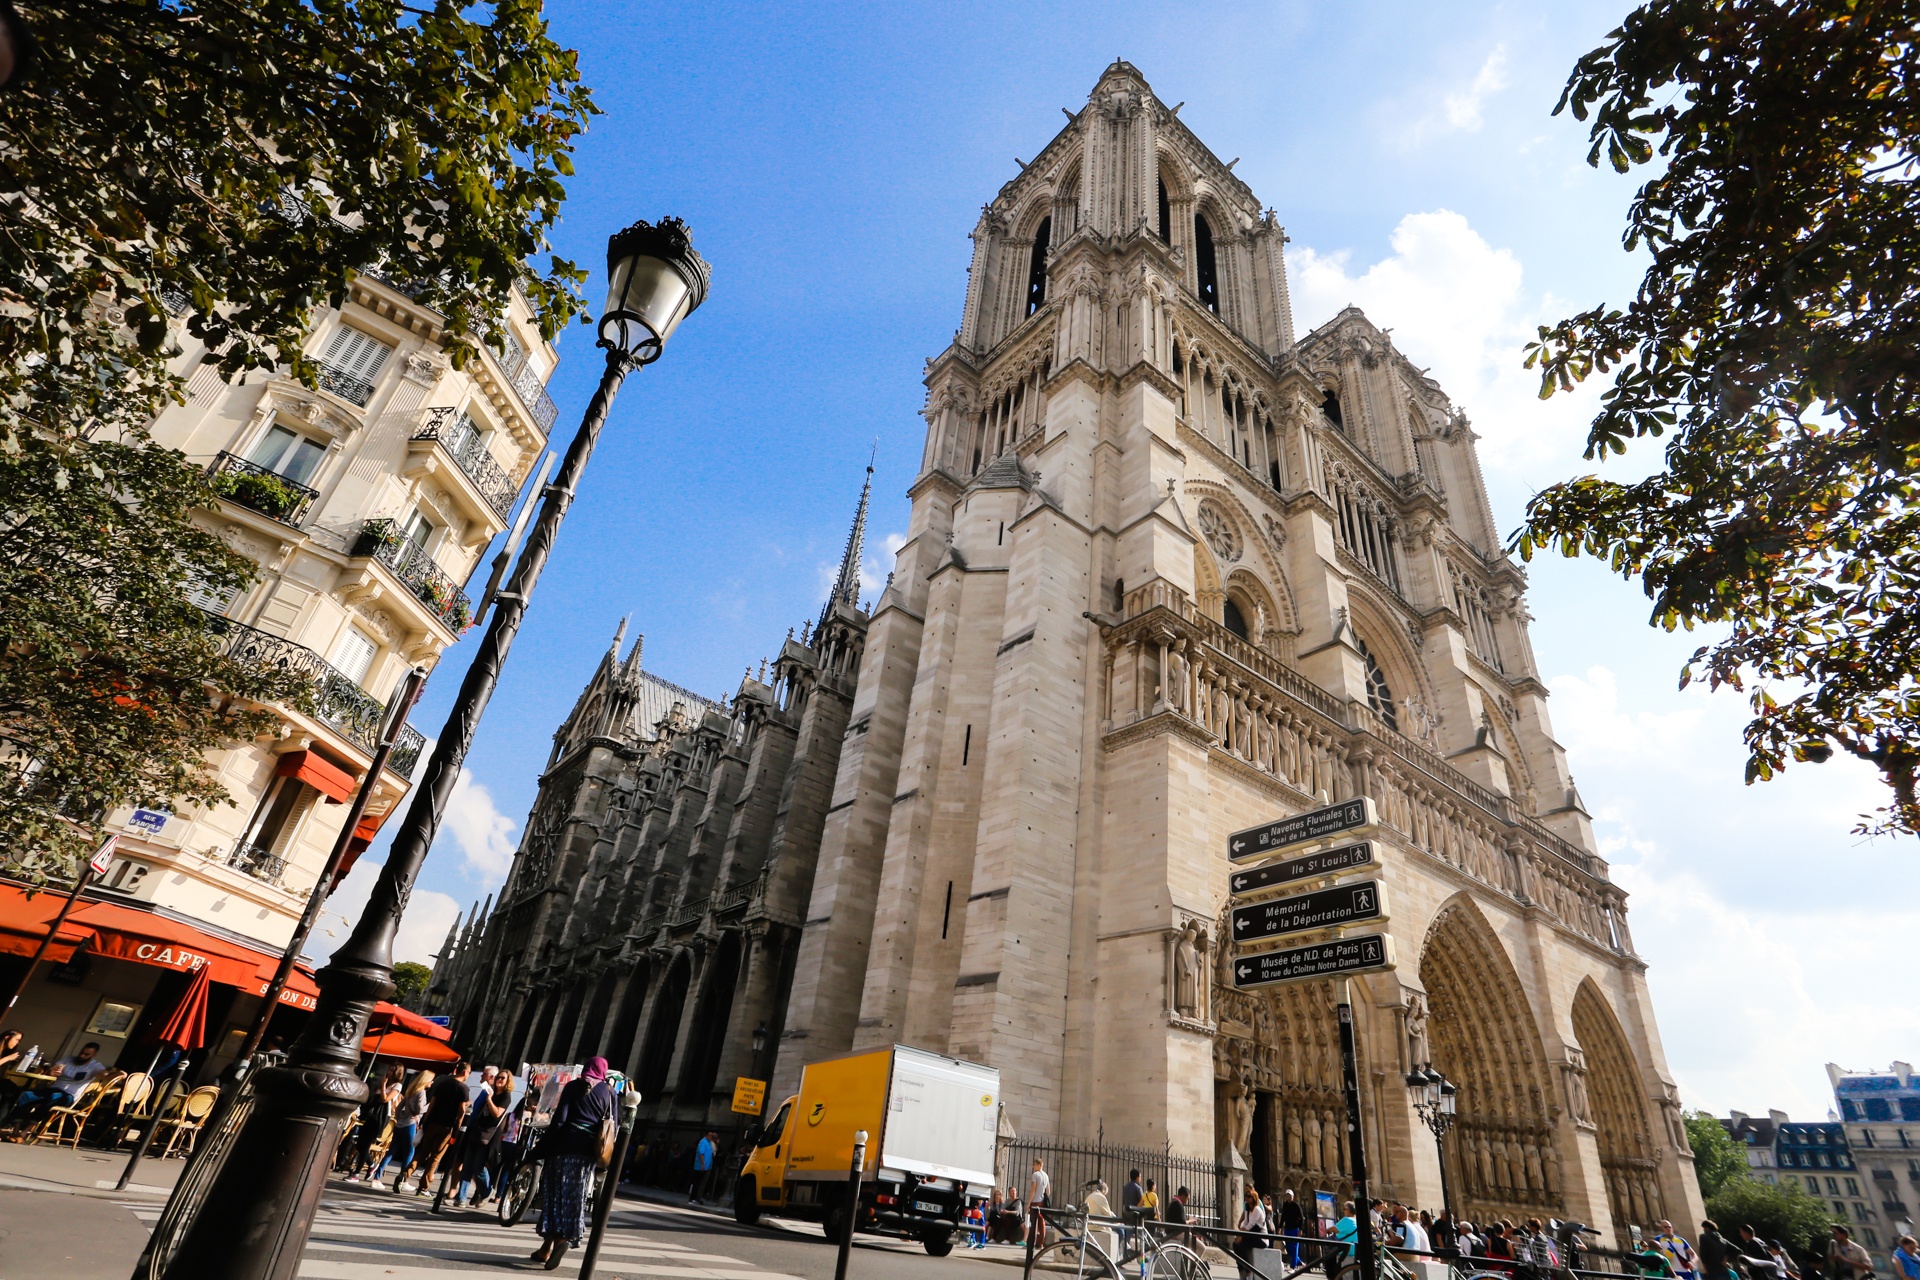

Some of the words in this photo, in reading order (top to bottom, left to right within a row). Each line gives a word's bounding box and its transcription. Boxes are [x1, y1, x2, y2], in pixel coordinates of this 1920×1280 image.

[130, 819, 162, 831] D'ARCOLE
[143, 814, 156, 822] RUE
[1270, 820, 1304, 836] Navettes
[1306, 810, 1343, 826] Fluviales
[1271, 834, 1287, 846] Quai
[1288, 832, 1298, 841] de
[1299, 830, 1307, 838] la
[1309, 820, 1343, 836] Tournelle
[1292, 865, 1304, 875] Ile
[1308, 860, 1318, 871] St
[1322, 854, 1348, 868] Louis
[1265, 900, 1310, 918] Mémorial
[1266, 921, 1277, 930] de
[1280, 918, 1289, 928] la
[1292, 908, 1352, 926] Déportation
[1261, 956, 1288, 968] Musée
[1290, 953, 1301, 964] de
[1303, 950, 1320, 962] N.D.
[1322, 948, 1334, 958] de
[1336, 944, 1359, 956] Paris
[1270, 970, 1282, 978] rue
[1283, 967, 1292, 975] du
[1293, 964, 1316, 974] Cloître
[1317, 961, 1337, 971] Notre
[1338, 957, 1360, 967] Dame
[259, 983, 300, 1003] SON
